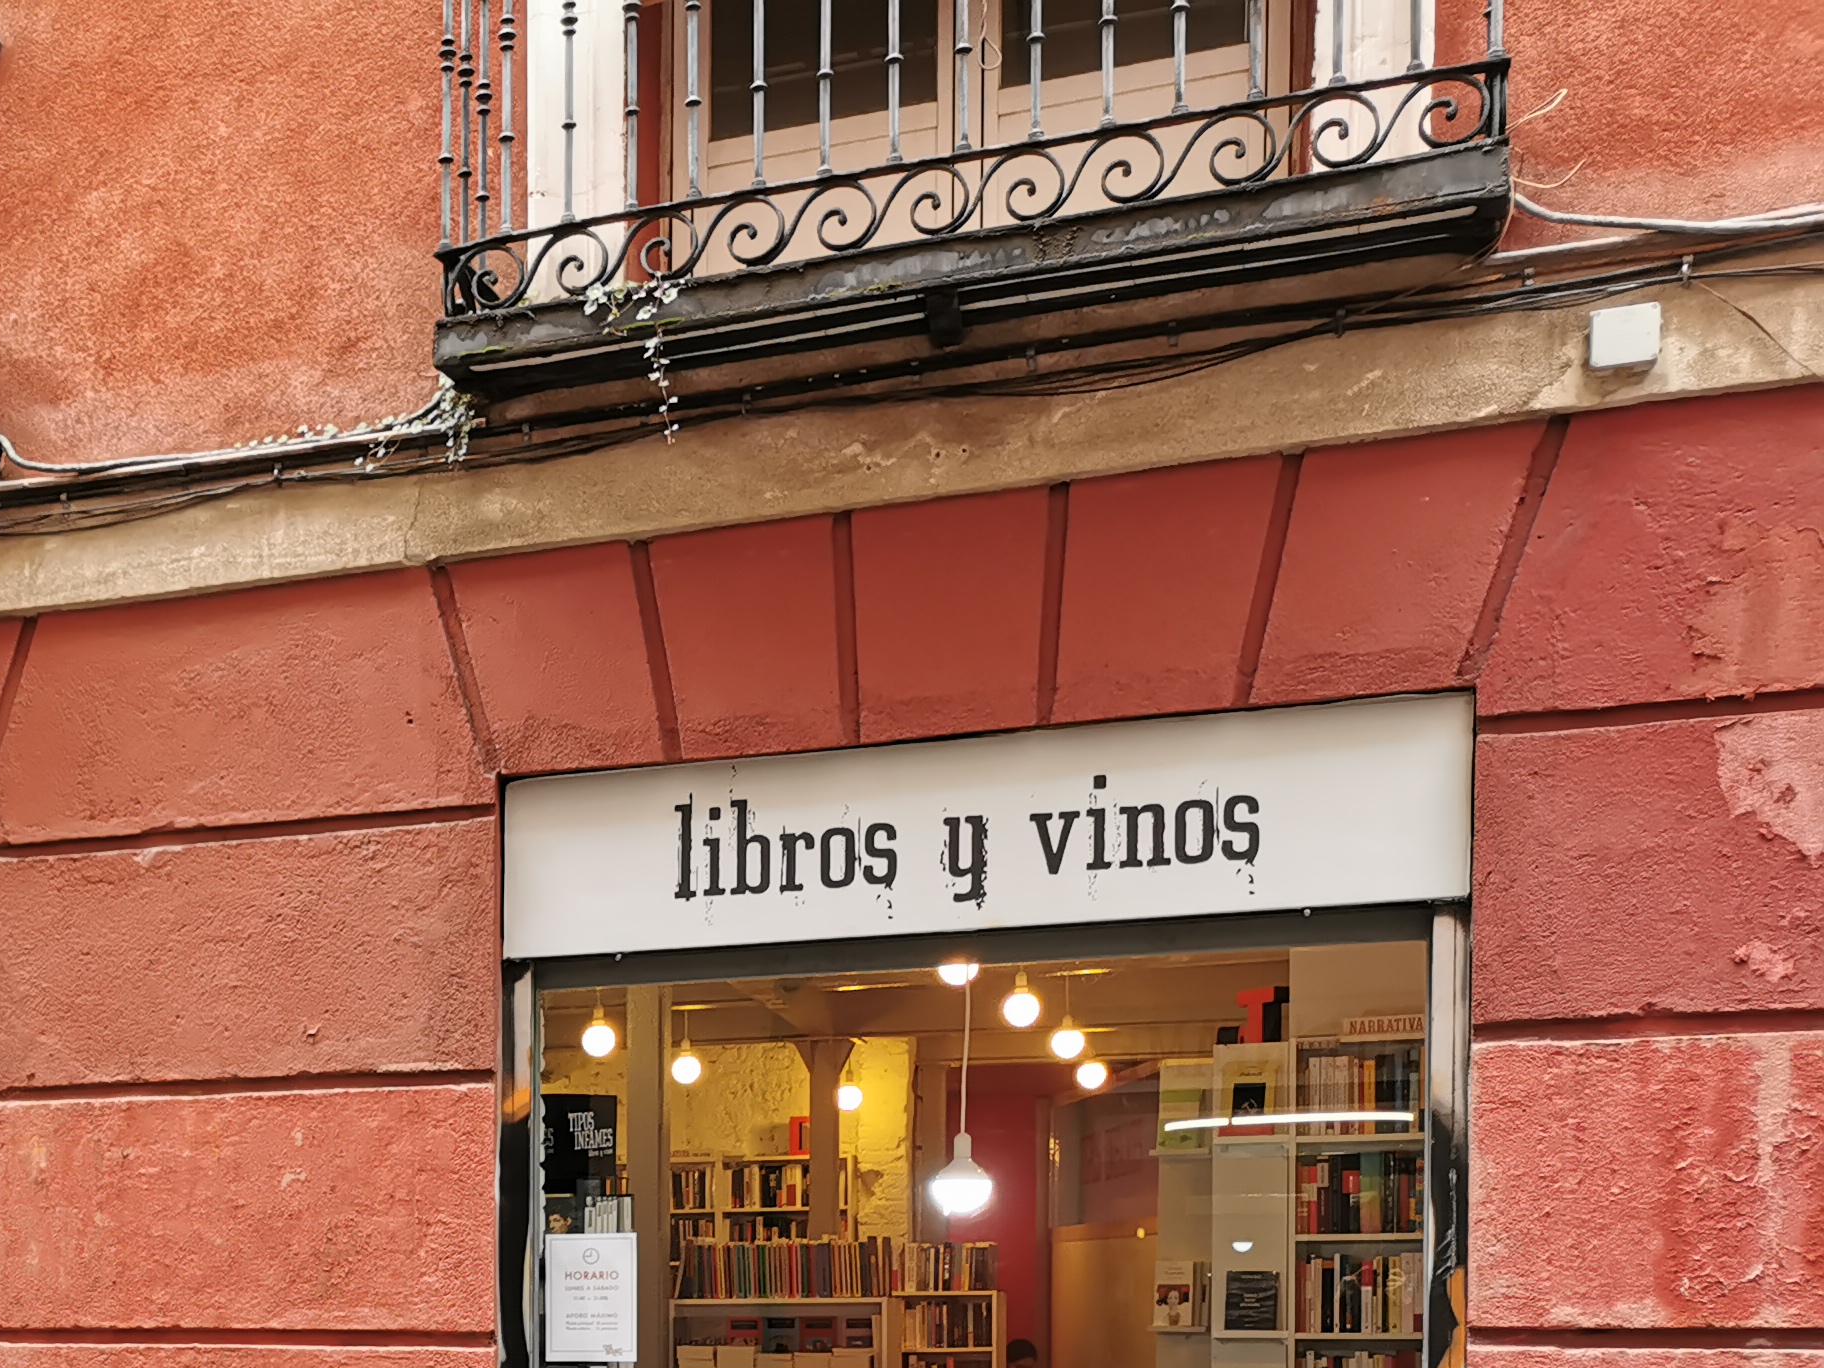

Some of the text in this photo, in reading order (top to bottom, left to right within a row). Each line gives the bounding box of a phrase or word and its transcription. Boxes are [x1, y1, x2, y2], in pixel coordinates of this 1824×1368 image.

[673, 774, 1262, 910] libros y vinos
[1348, 1016, 1425, 1035] NARRATIVA
[567, 1111, 595, 1132] TIPOS
[574, 1128, 614, 1151] INFAMES
[564, 1269, 620, 1281] HORARIO
